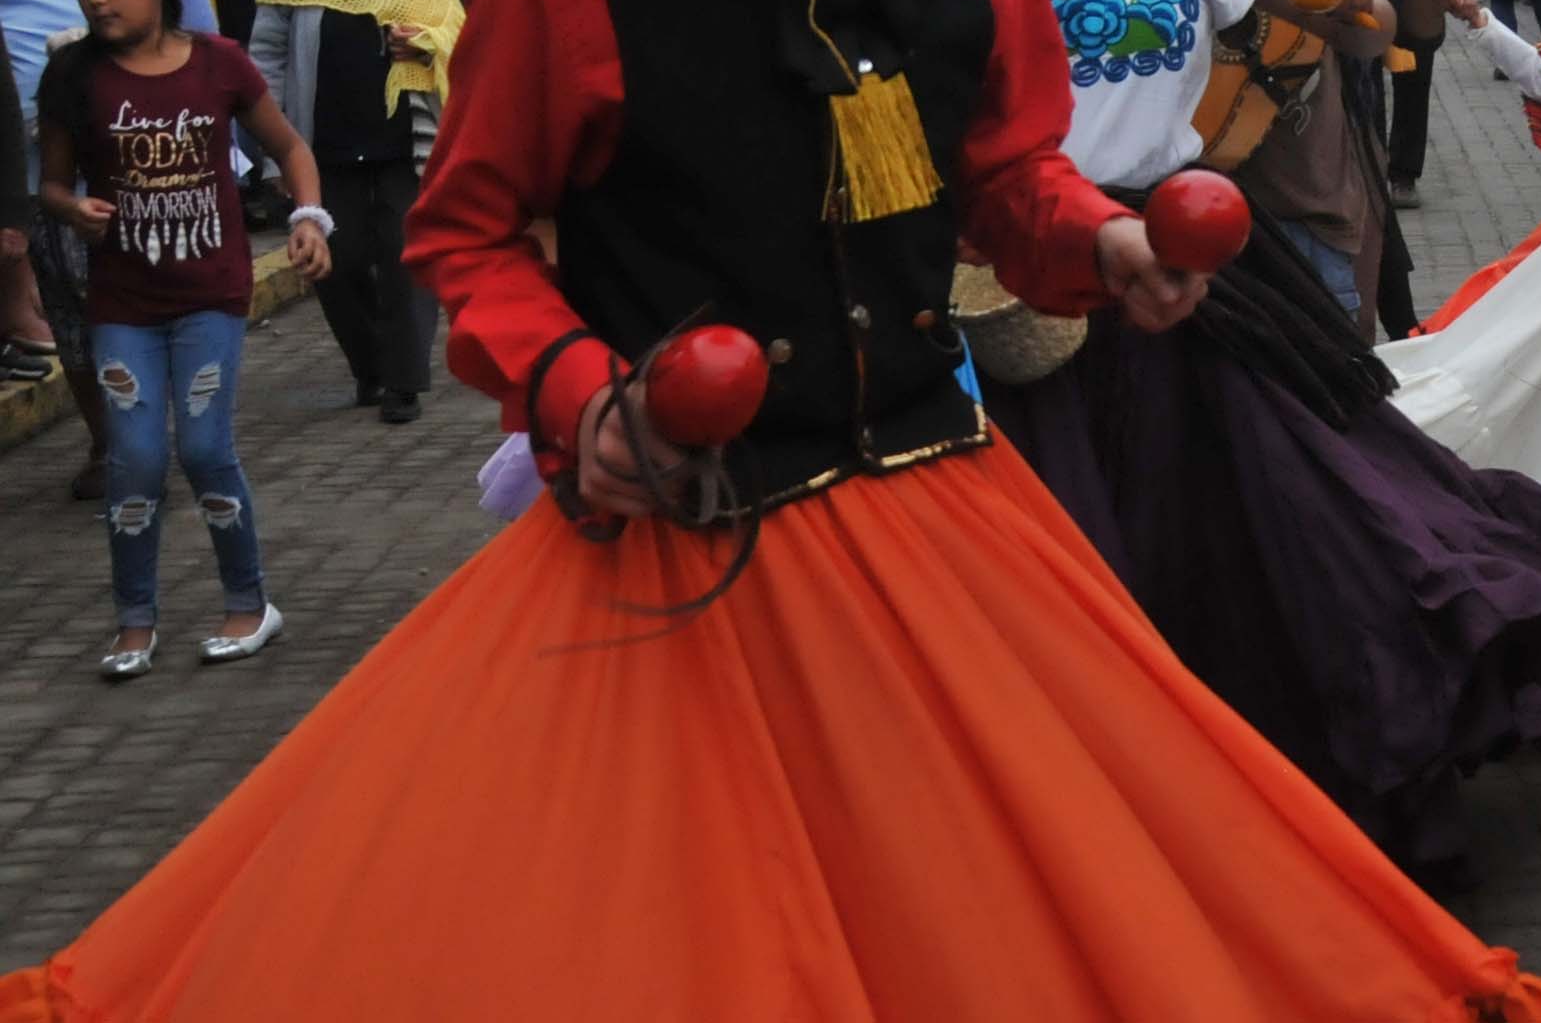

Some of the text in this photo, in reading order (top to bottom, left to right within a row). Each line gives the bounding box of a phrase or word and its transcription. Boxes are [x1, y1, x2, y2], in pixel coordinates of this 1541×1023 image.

[108, 99, 215, 141] Live for
[111, 129, 213, 168] TODAY
[115, 183, 217, 220] TOMORROW
